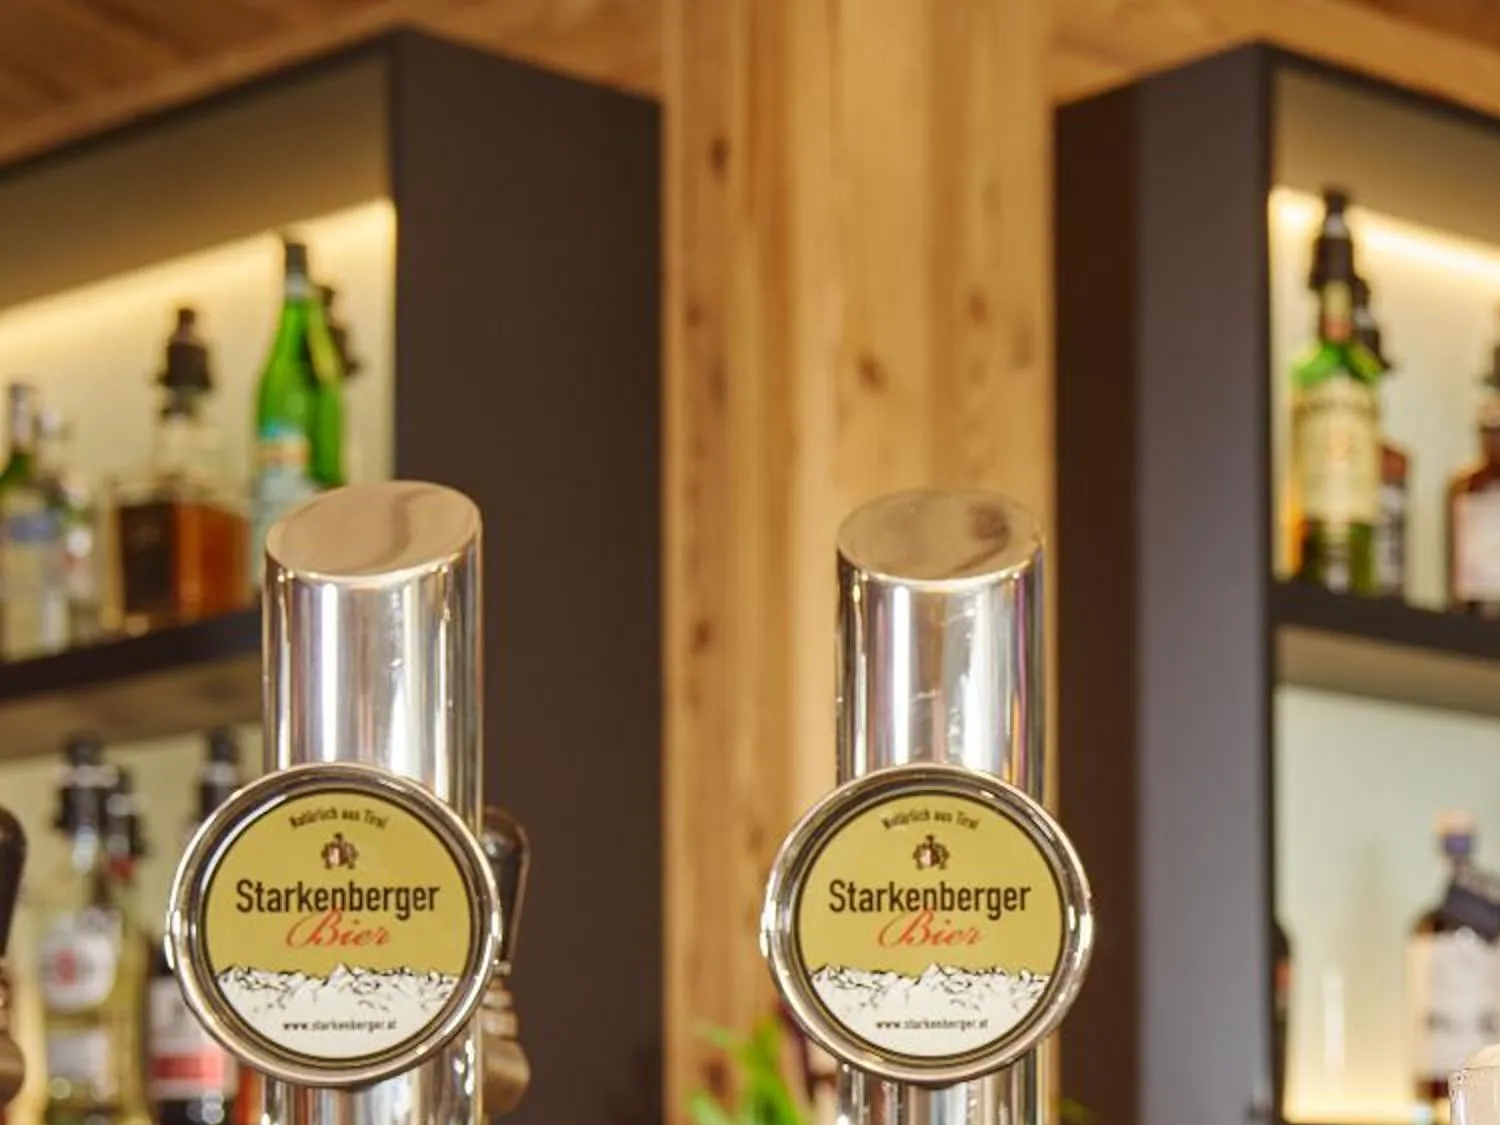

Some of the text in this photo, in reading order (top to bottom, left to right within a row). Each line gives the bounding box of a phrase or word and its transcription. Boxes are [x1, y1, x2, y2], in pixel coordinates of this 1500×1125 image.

[236, 879, 440, 920] Starkenberger
[829, 880, 1031, 920] Starkenberger
[286, 906, 391, 947] Bier
[878, 907, 981, 947] Bier
